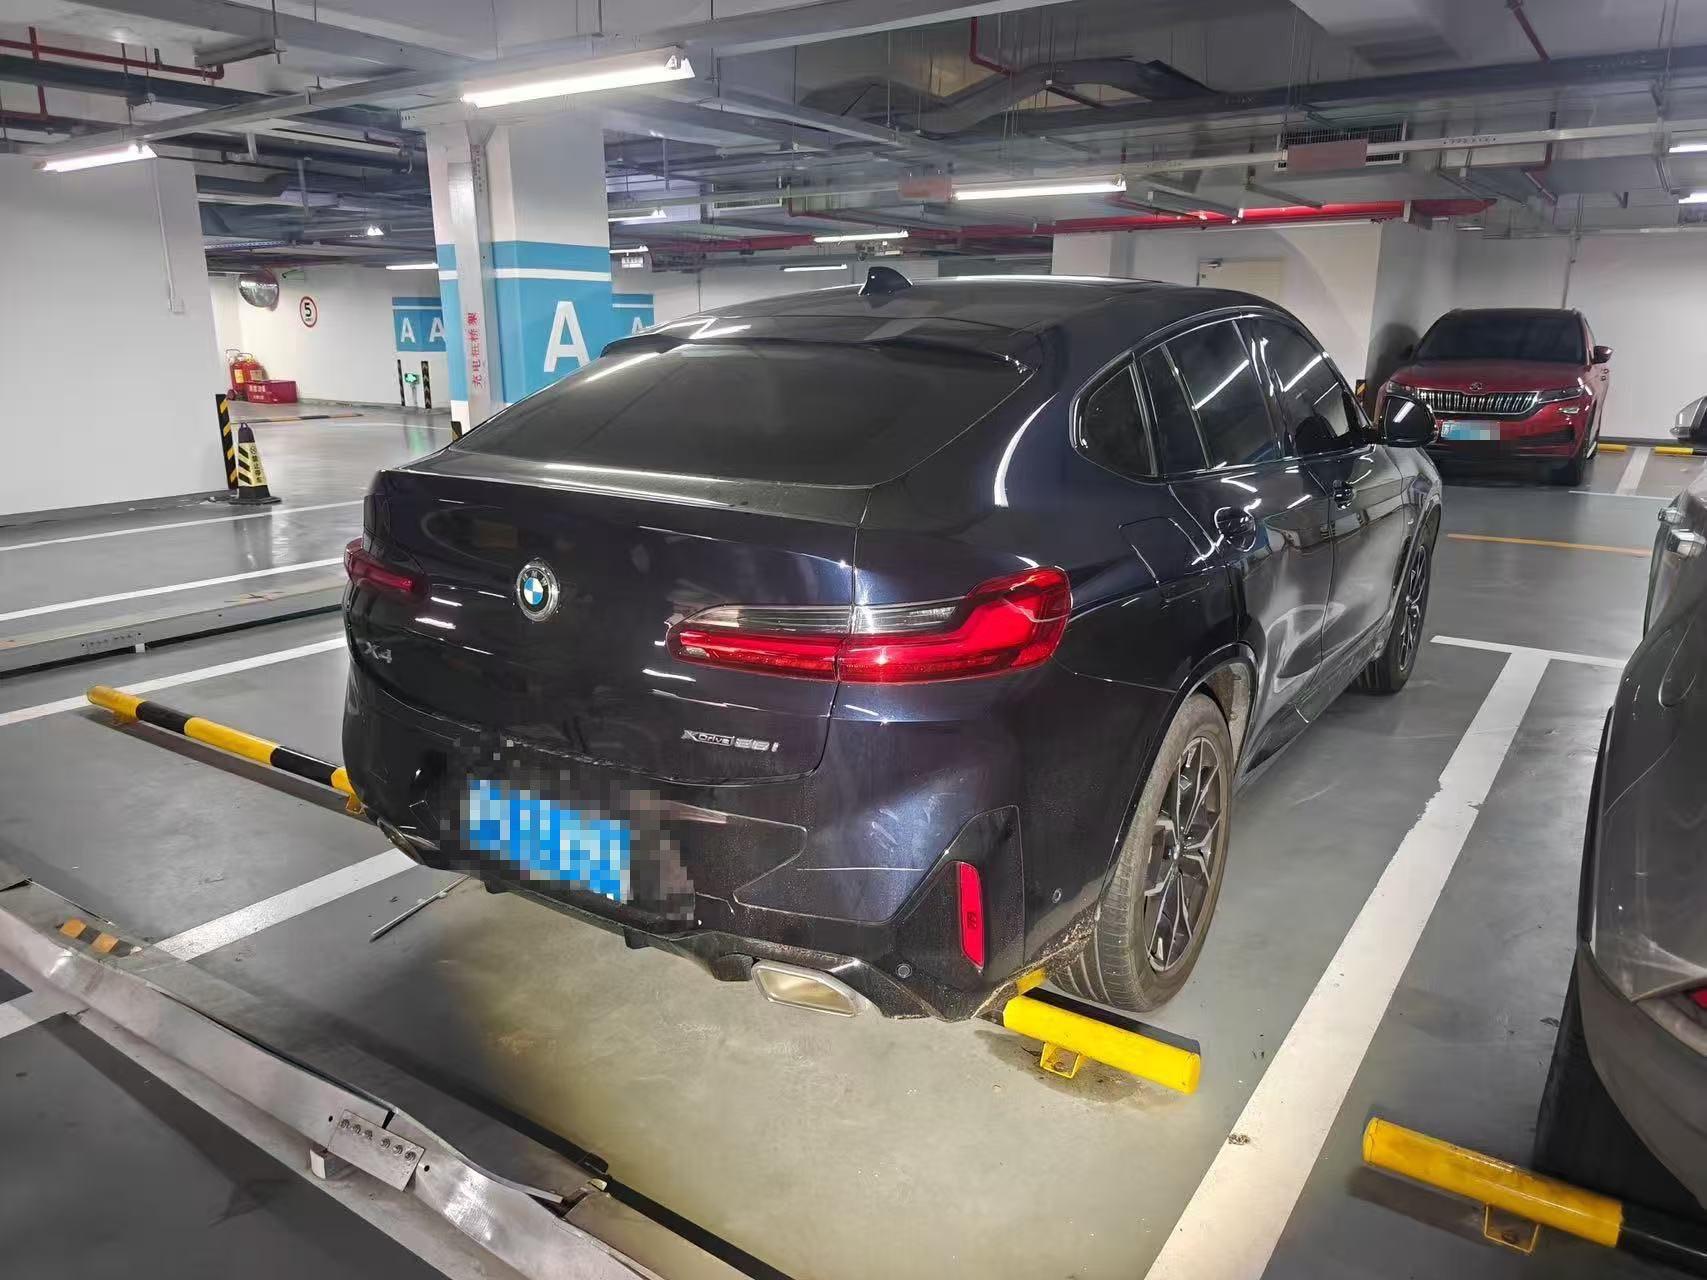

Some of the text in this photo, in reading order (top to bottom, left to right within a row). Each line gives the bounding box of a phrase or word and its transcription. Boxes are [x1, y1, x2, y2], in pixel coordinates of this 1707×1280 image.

[304, 302, 312, 317] 5
[400, 317, 416, 343] A
[429, 317, 447, 343] A
[544, 301, 591, 373] A
[363, 641, 393, 664] X4
